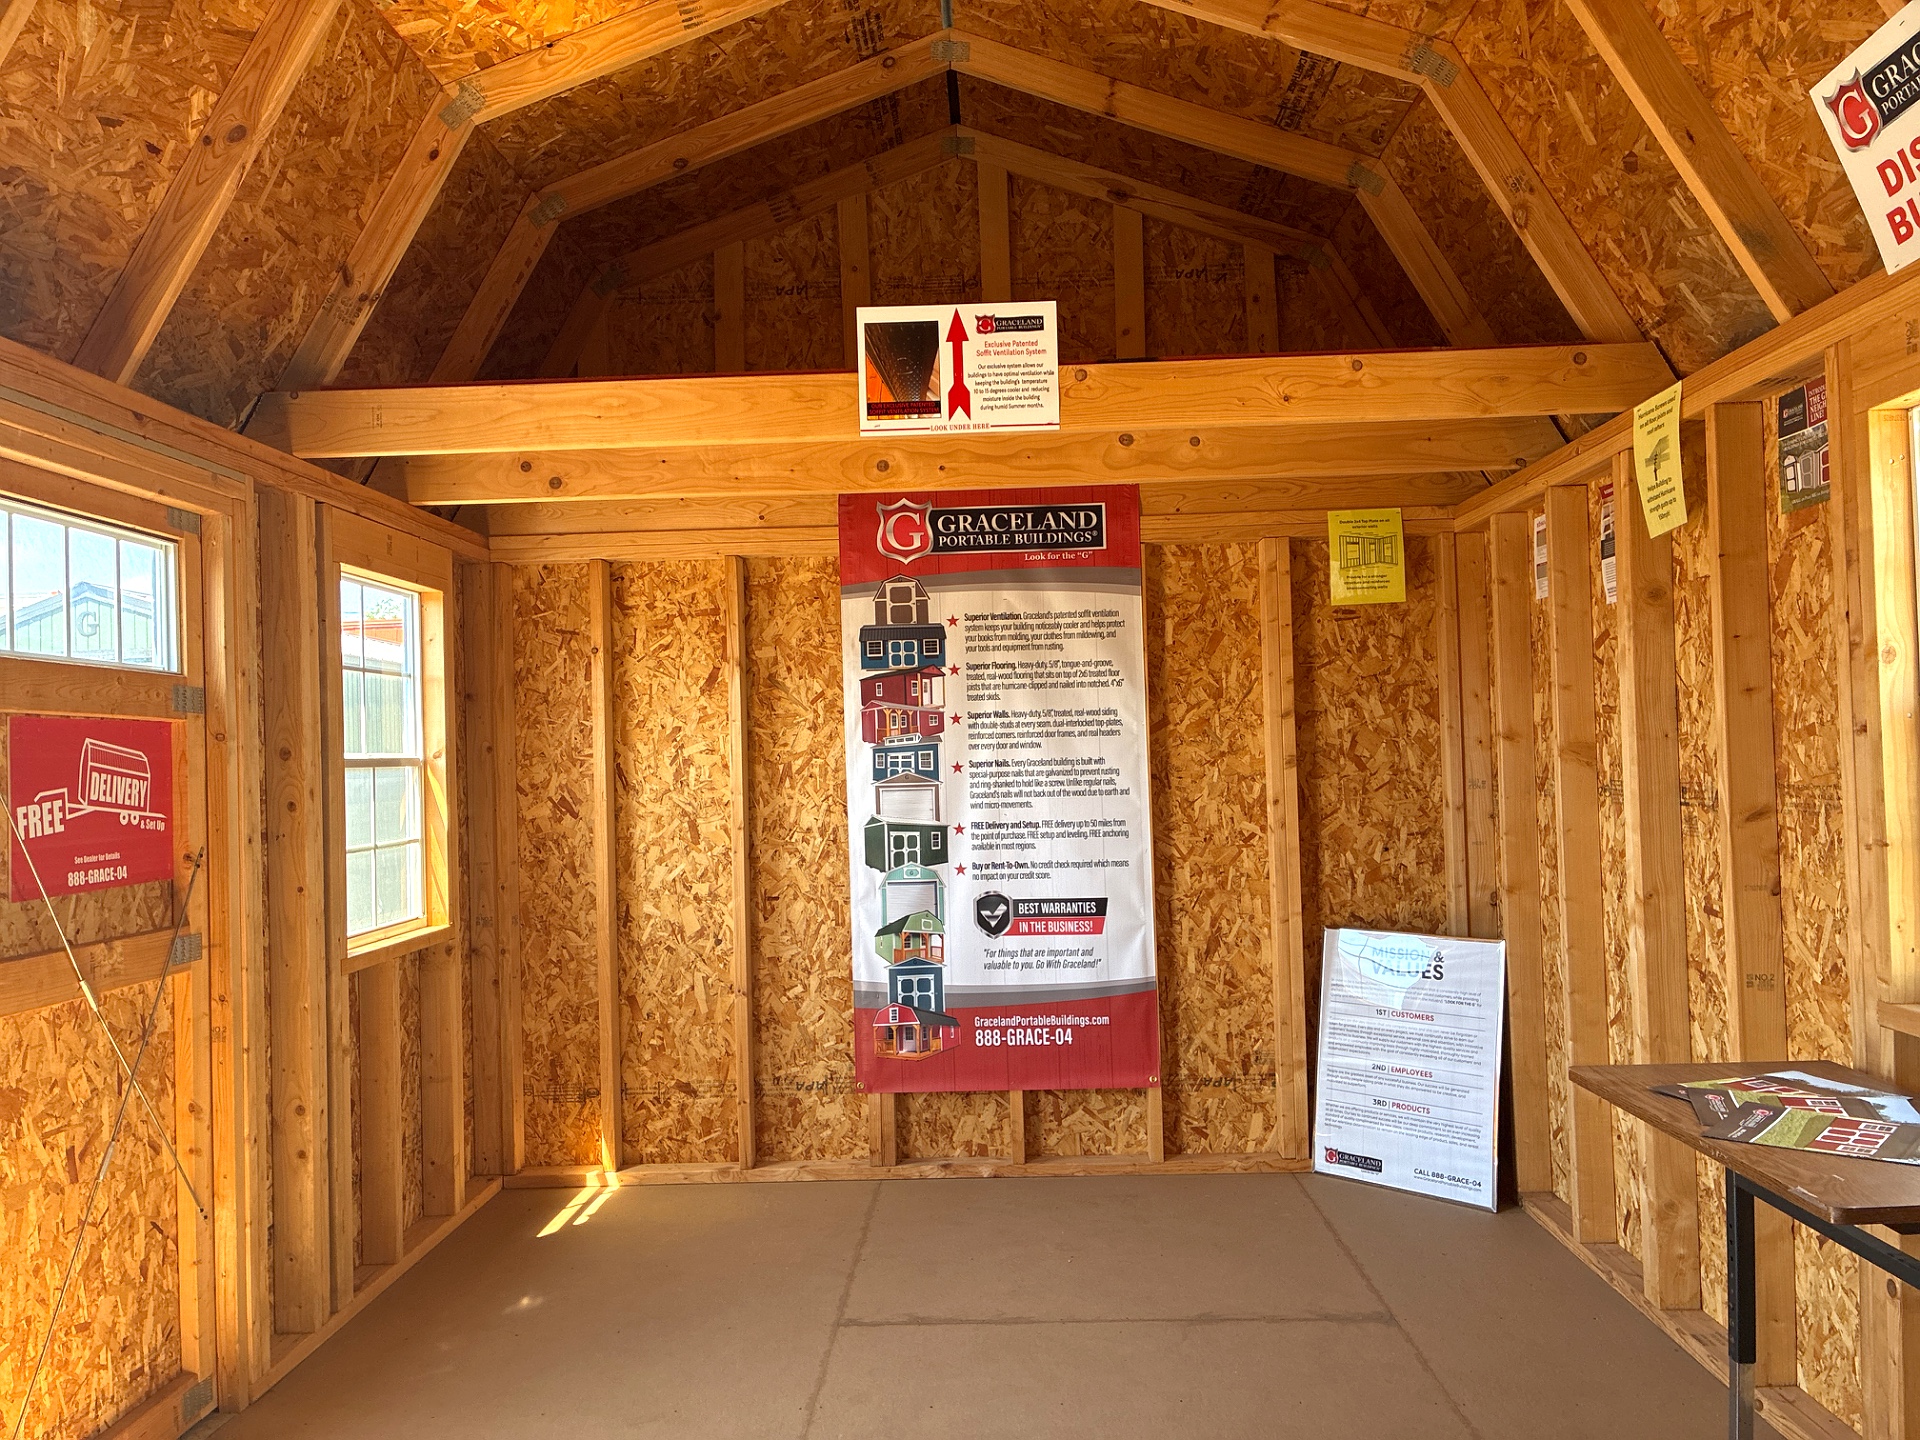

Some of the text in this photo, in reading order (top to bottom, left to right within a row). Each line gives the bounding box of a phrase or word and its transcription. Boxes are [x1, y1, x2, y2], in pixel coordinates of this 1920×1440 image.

[1838, 88, 1873, 139] G
[984, 340, 1038, 348] Exclusive Patented
[976, 348, 1046, 358] Soffit Ventilation System
[886, 511, 1098, 550] G GRACELAND
[939, 533, 1011, 547] PORTABLE
[1024, 553, 1046, 561] Look
[1047, 552, 1060, 560] for
[1062, 552, 1076, 560] the
[964, 612, 989, 622] Superior
[989, 611, 1022, 620] Ventilation.
[1053, 610, 1077, 620] patented
[1077, 610, 1091, 618] soffit
[1091, 609, 1119, 618] ventilation
[967, 692, 1000, 701] treated skids.
[968, 759, 993, 770] Superior
[994, 759, 1010, 767] Nails.
[1011, 758, 1026, 769] Every
[1026, 758, 1052, 766] Graceland
[1053, 758, 1075, 768] building
[1080, 757, 1092, 765] built
[1093, 757, 1105, 765] with
[90, 771, 148, 808] DELIVERY
[970, 800, 1033, 809] wind micro-movements.
[16, 799, 65, 840] FREE
[157, 820, 165, 832] Up
[971, 821, 984, 829] FREE
[985, 820, 1009, 831] Delivery
[1010, 820, 1021, 828] and
[1022, 820, 1040, 830] Setup.
[1041, 820, 1053, 828] FREE
[1054, 819, 1075, 830] delivery
[1084, 819, 1090, 827] to
[1090, 819, 1097, 827] 50
[1098, 819, 1112, 827] miles
[1112, 819, 1126, 827] from
[74, 856, 83, 864] See
[84, 854, 98, 864] Dealer
[105, 852, 120, 861] Details
[972, 862, 983, 872] Buy
[991, 861, 1029, 869] Rent-To-Own.
[1030, 861, 1038, 869] No
[1038, 860, 1053, 868] credit
[1054, 860, 1070, 868] check
[1070, 860, 1093, 870] required
[1093, 860, 1110, 868] which
[67, 866, 128, 887] 888-GRACE-04
[1018, 902, 1096, 915] BEST WARRANTIES
[1019, 920, 1093, 933] IN THE BUSINESS!
[997, 948, 1018, 960] things
[1019, 948, 1033, 957] that
[1046, 947, 1079, 959] important
[1080, 947, 1093, 956] and
[1372, 947, 1445, 963] MISSION &
[983, 960, 1011, 970] valuable
[1012, 960, 1019, 969] to
[1020, 963, 1034, 971] you.
[1035, 960, 1044, 969] Go
[1046, 959, 1061, 969] With
[1372, 959, 1444, 980] VALUES
[974, 1015, 1110, 1028] GracelandPortableBuildings.com
[1376, 1008, 1435, 1022] 1ST CUSTOMERS
[975, 1028, 1073, 1047] 888-GRACE-04
[1372, 1063, 1433, 1079] 2ND EMPLOYEES
[1372, 1098, 1431, 1115] 3RD PRODUCTS
[1338, 1152, 1383, 1167] GRACELAND
[1414, 1168, 1482, 1188] CALL 888-GRACE-04
